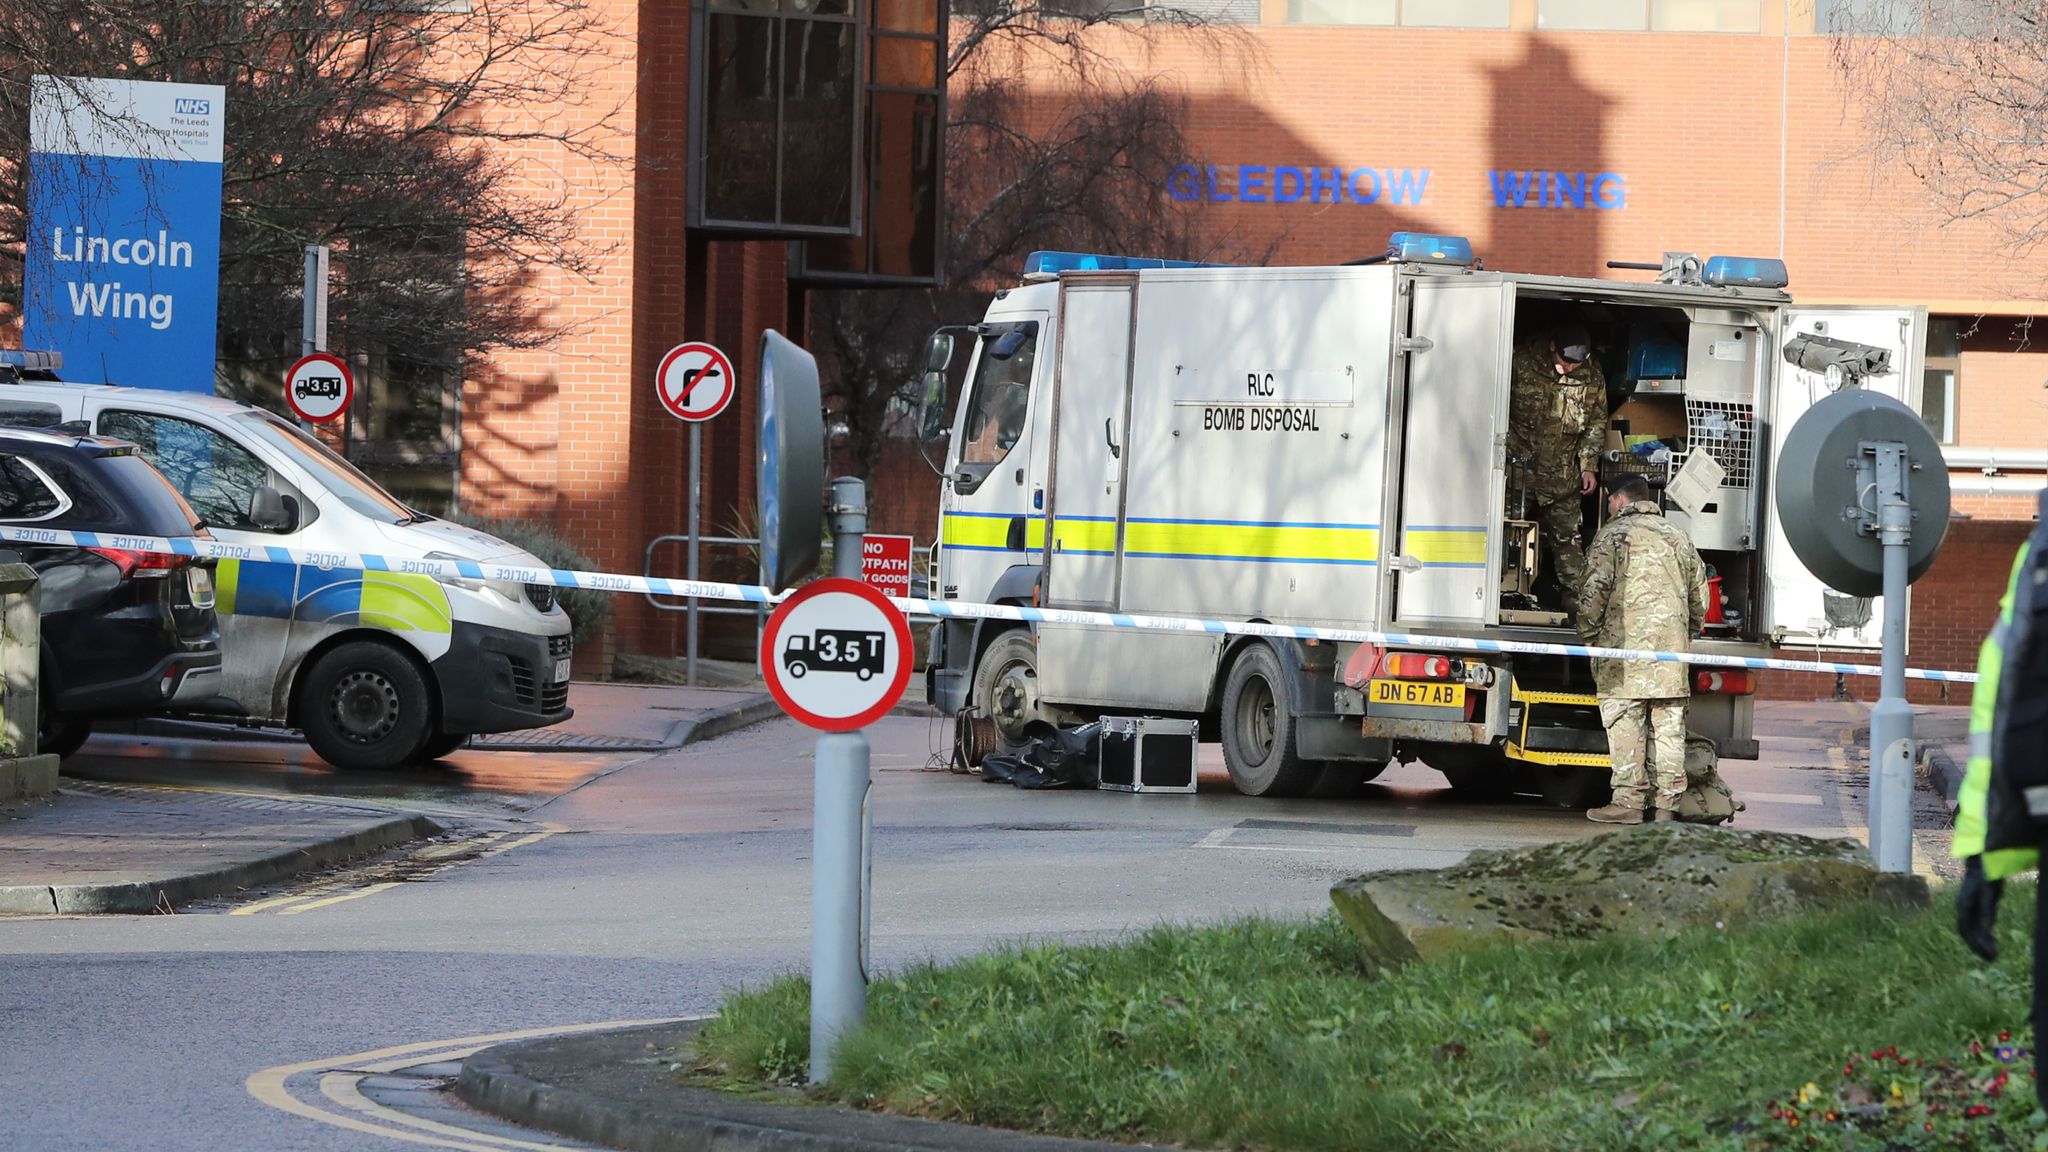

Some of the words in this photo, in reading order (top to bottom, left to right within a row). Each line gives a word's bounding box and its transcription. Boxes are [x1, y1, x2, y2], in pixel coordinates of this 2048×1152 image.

[176, 99, 209, 114] NHS
[170, 117, 185, 125] The
[187, 118, 209, 126] Leeds
[172, 128, 208, 138] Hospitals
[1167, 164, 1431, 206] GLEDHOW
[1487, 170, 1627, 209] WING
[53, 226, 193, 268] Lincoln
[68, 281, 173, 330] Wing
[1247, 373, 1274, 397] RLC
[1204, 408, 1245, 431] BOMB
[1250, 408, 1320, 432] DISPOSAL
[15, 529, 56, 542] POLICE
[112, 537, 154, 550] POLICE
[864, 543, 883, 554] NO
[209, 544, 250, 558] POLICE
[305, 552, 347, 566] POLICE
[401, 560, 442, 574] POLICE
[496, 568, 537, 582] POLICE
[871, 574, 908, 584] GOODS
[590, 576, 631, 590] POLICE
[684, 583, 726, 597] POLICE
[963, 604, 1003, 617] POLICE
[1055, 612, 1095, 624] POLICE
[1147, 617, 1187, 629] POLICE
[1238, 624, 1278, 635] POLICE
[1379, 683, 1401, 701] DN
[1406, 685, 1428, 702] 67
[1432, 686, 1454, 704] AB
